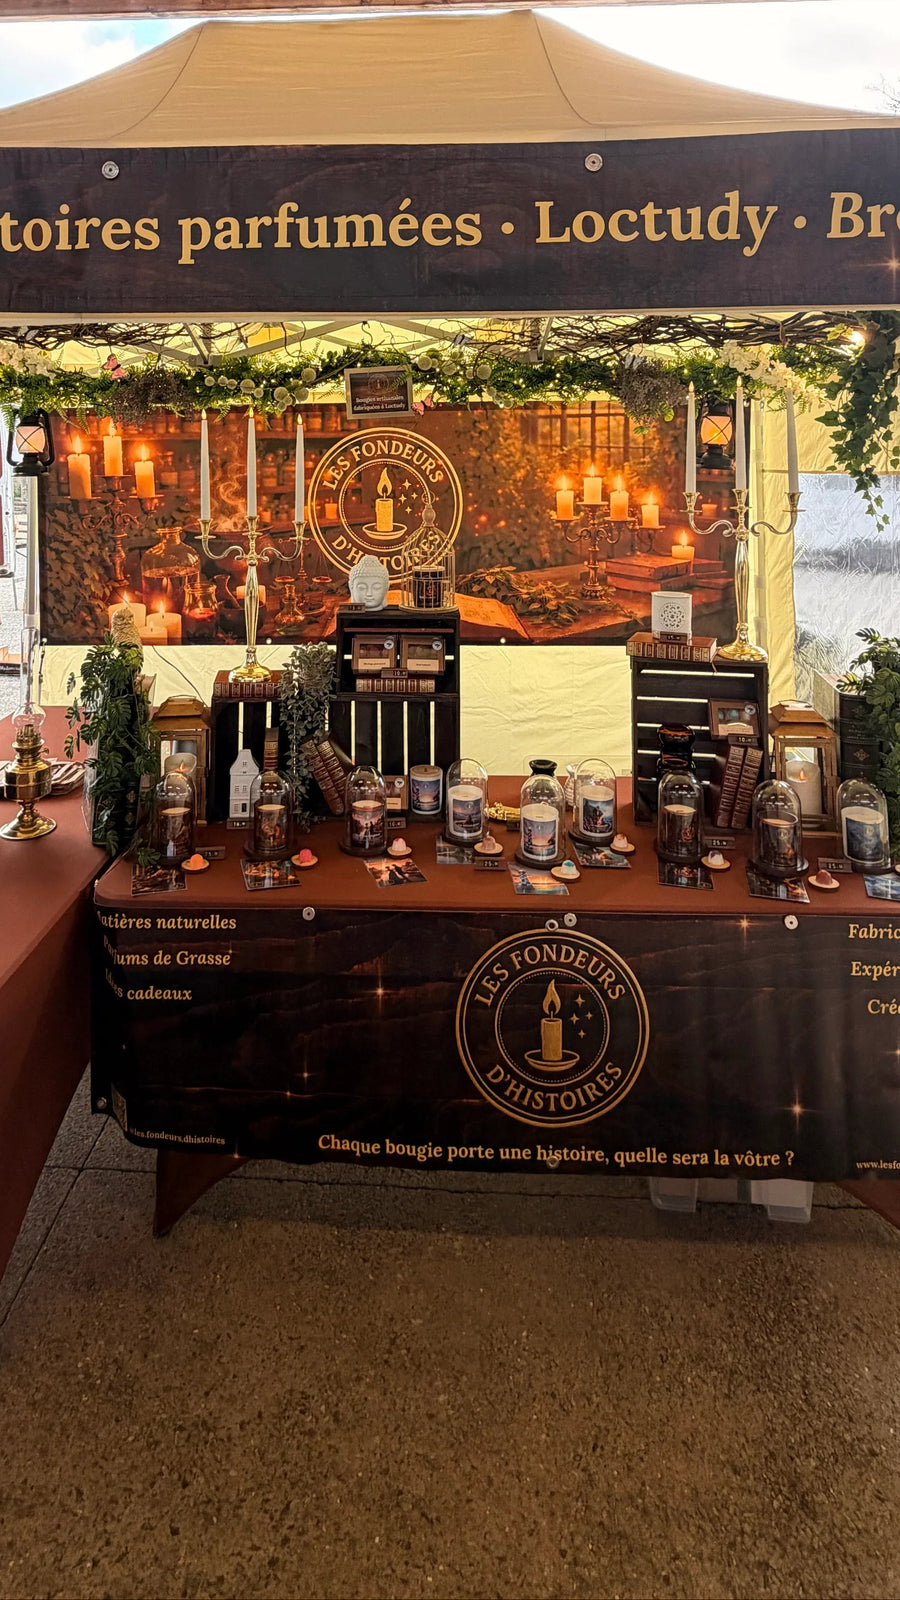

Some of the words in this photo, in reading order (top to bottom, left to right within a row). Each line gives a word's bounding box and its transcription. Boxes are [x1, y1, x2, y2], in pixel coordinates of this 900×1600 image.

[178, 198, 483, 265] parfumées
[535, 190, 778, 257] Loctudy
[826, 191, 900, 239] Br
[322, 456, 351, 490] LES
[351, 440, 444, 483] FONDEURS
[332, 531, 440, 571] D'HTOIRES
[156, 914, 237, 929] naturelles
[153, 950, 172, 966] de
[176, 951, 231, 966] Grasse
[474, 963, 510, 1007] LES
[509, 943, 626, 1000] FONDEURS
[126, 985, 193, 1000] cadeaux
[867, 998, 900, 1015] Cré
[486, 1061, 623, 1112] D'HISTOIRES
[318, 1134, 381, 1157] Chaque
[385, 1138, 443, 1162] bougie
[447, 1144, 495, 1162] porte
[499, 1146, 532, 1160] une
[536, 1145, 610, 1165] histoire,
[614, 1147, 668, 1168] quelle
[672, 1151, 709, 1166] sera
[714, 1149, 730, 1165] la
[734, 1150, 781, 1167] vôtre
